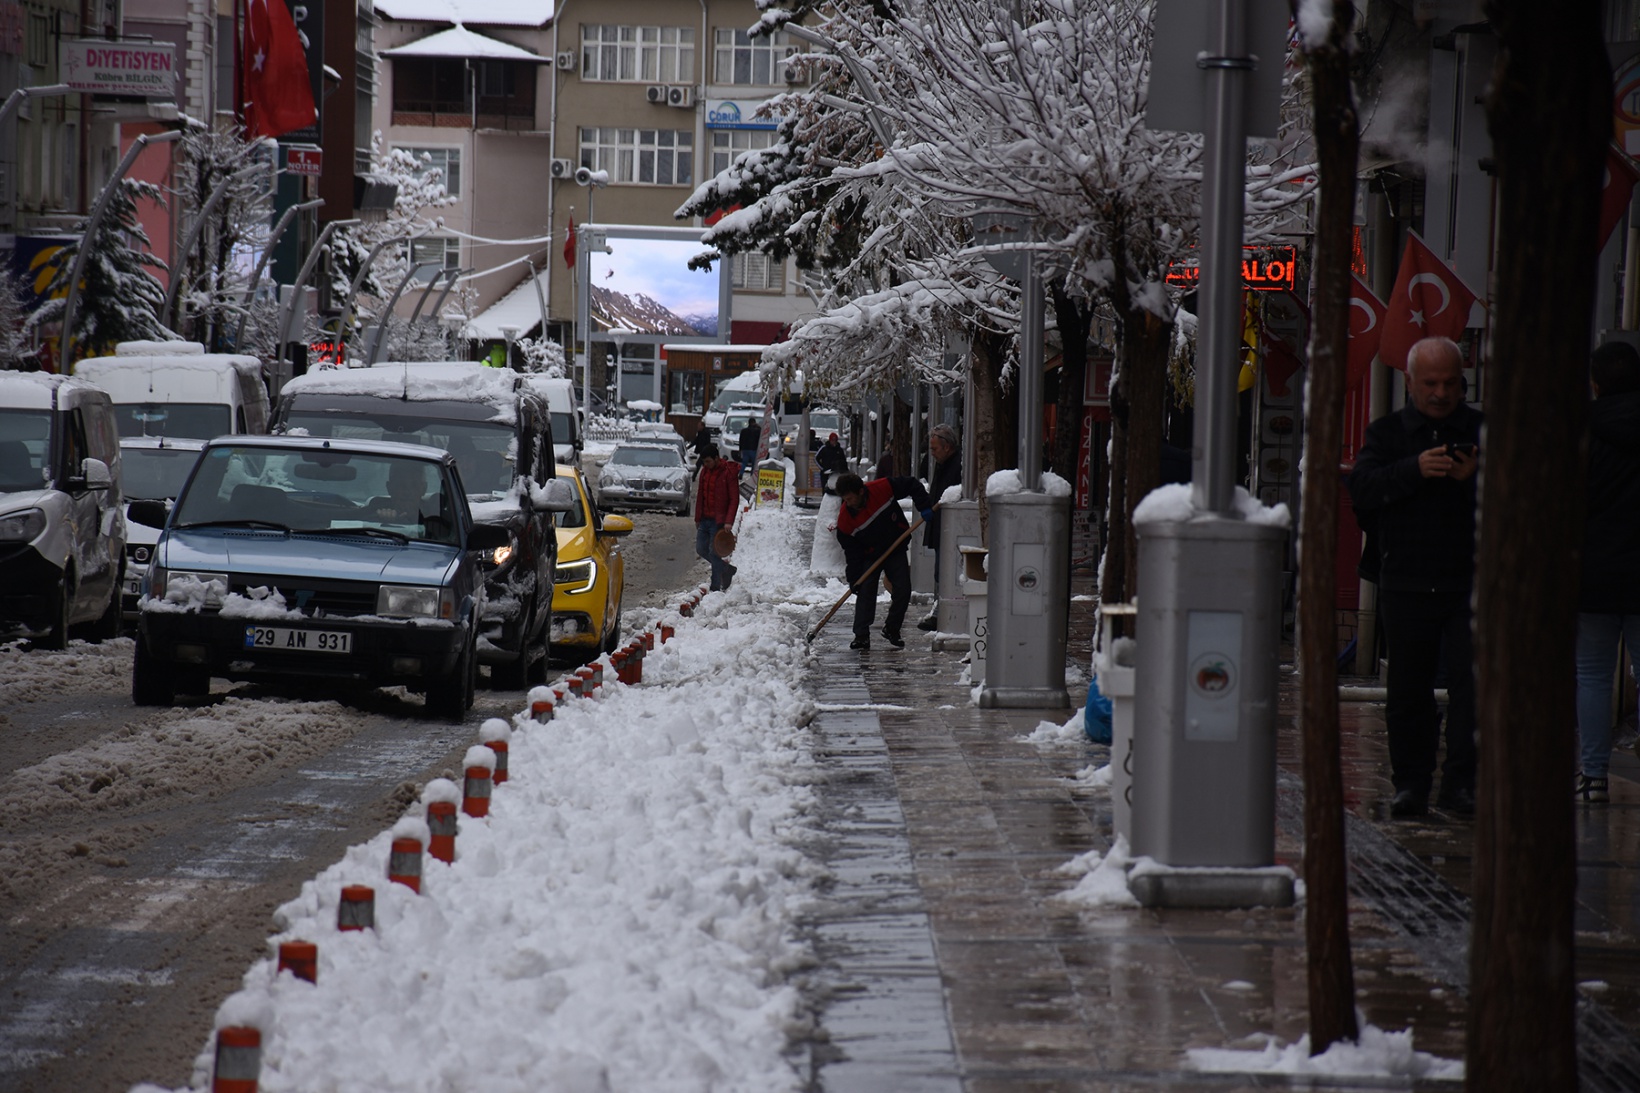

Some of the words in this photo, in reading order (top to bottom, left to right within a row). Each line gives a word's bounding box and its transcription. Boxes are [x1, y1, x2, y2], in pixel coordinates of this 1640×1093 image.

[255, 629, 275, 645] 29
[286, 631, 307, 648] AN
[318, 633, 347, 650] 931
